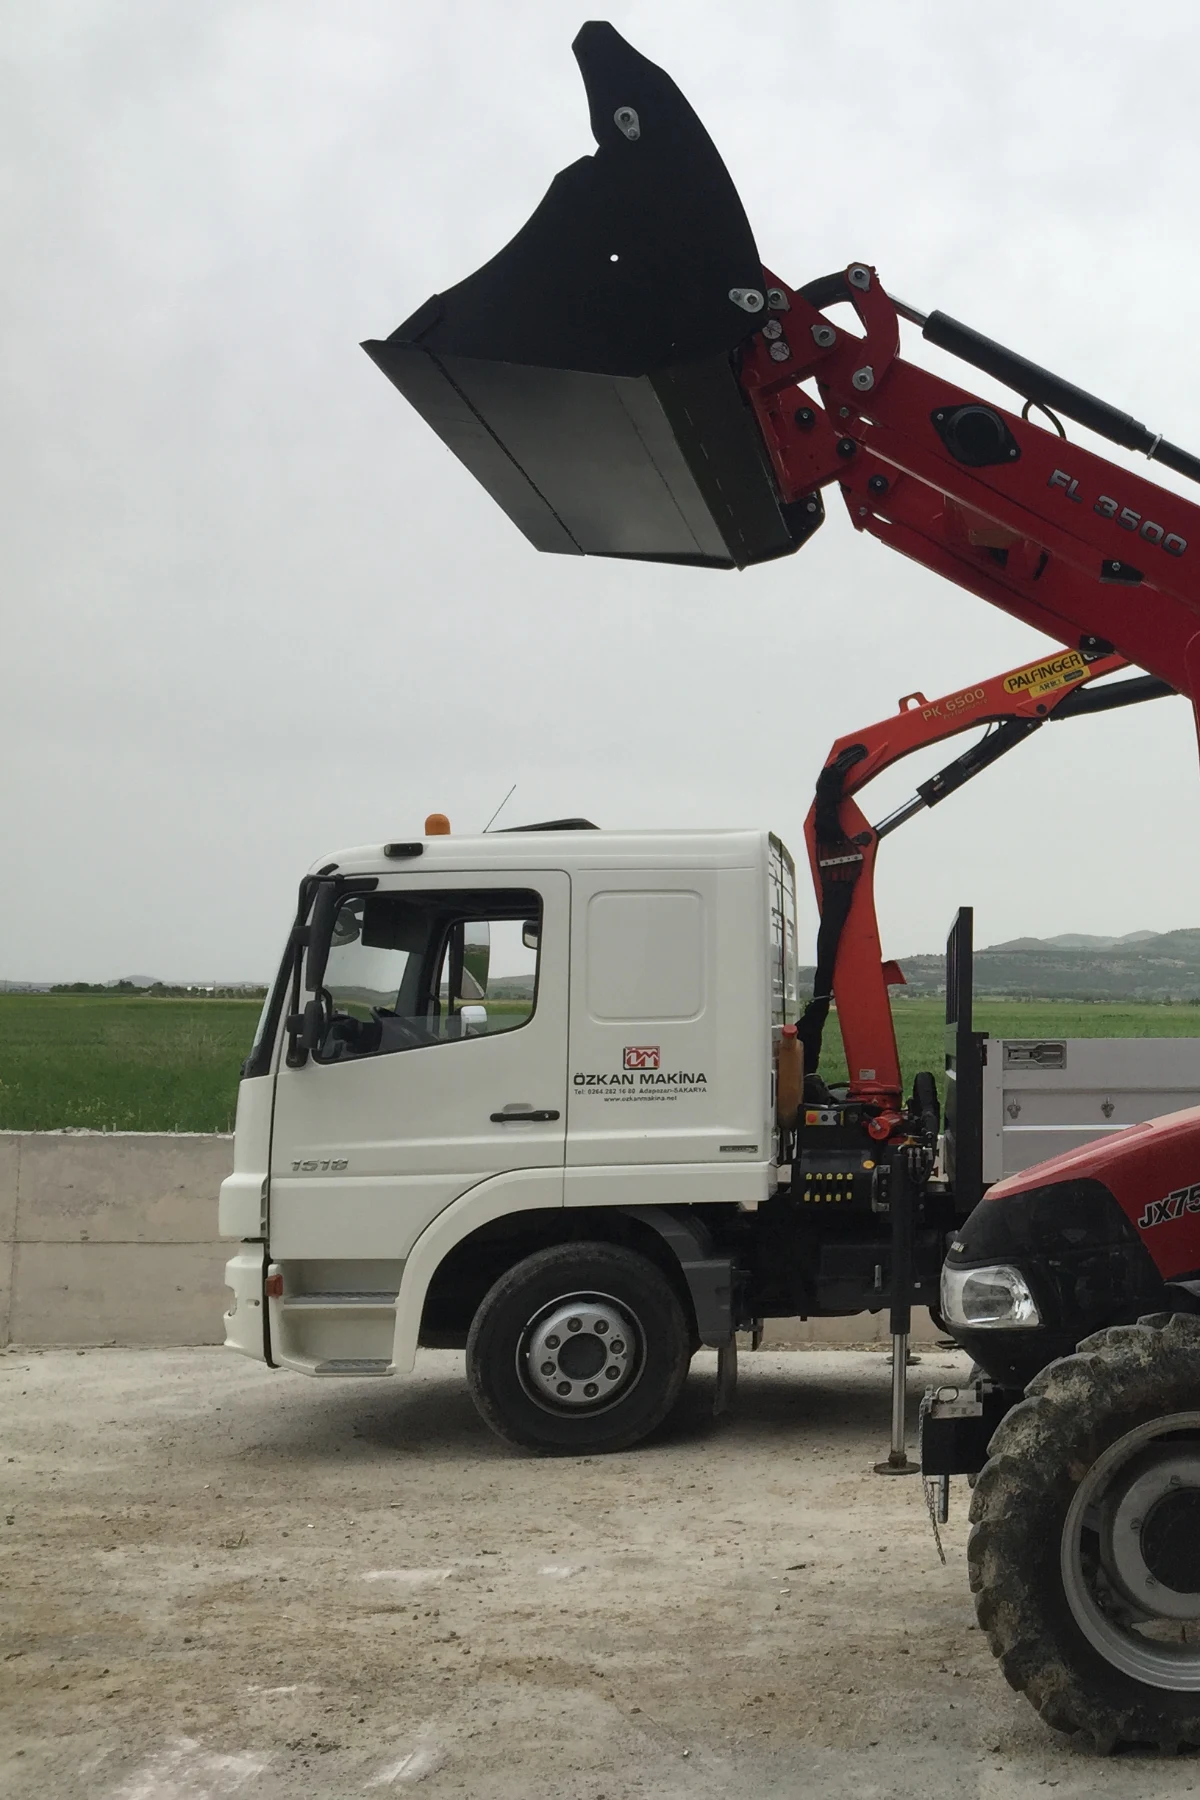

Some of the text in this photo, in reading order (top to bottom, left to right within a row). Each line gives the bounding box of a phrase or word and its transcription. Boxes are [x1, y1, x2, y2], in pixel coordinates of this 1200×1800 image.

[1047, 469, 1187, 557] FL 3500
[1007, 653, 1081, 691] PALFINGER
[922, 688, 985, 721] PK 6500
[573, 1071, 707, 1085] ÖZKAN MAKİNA
[291, 1160, 349, 1171] 1518
